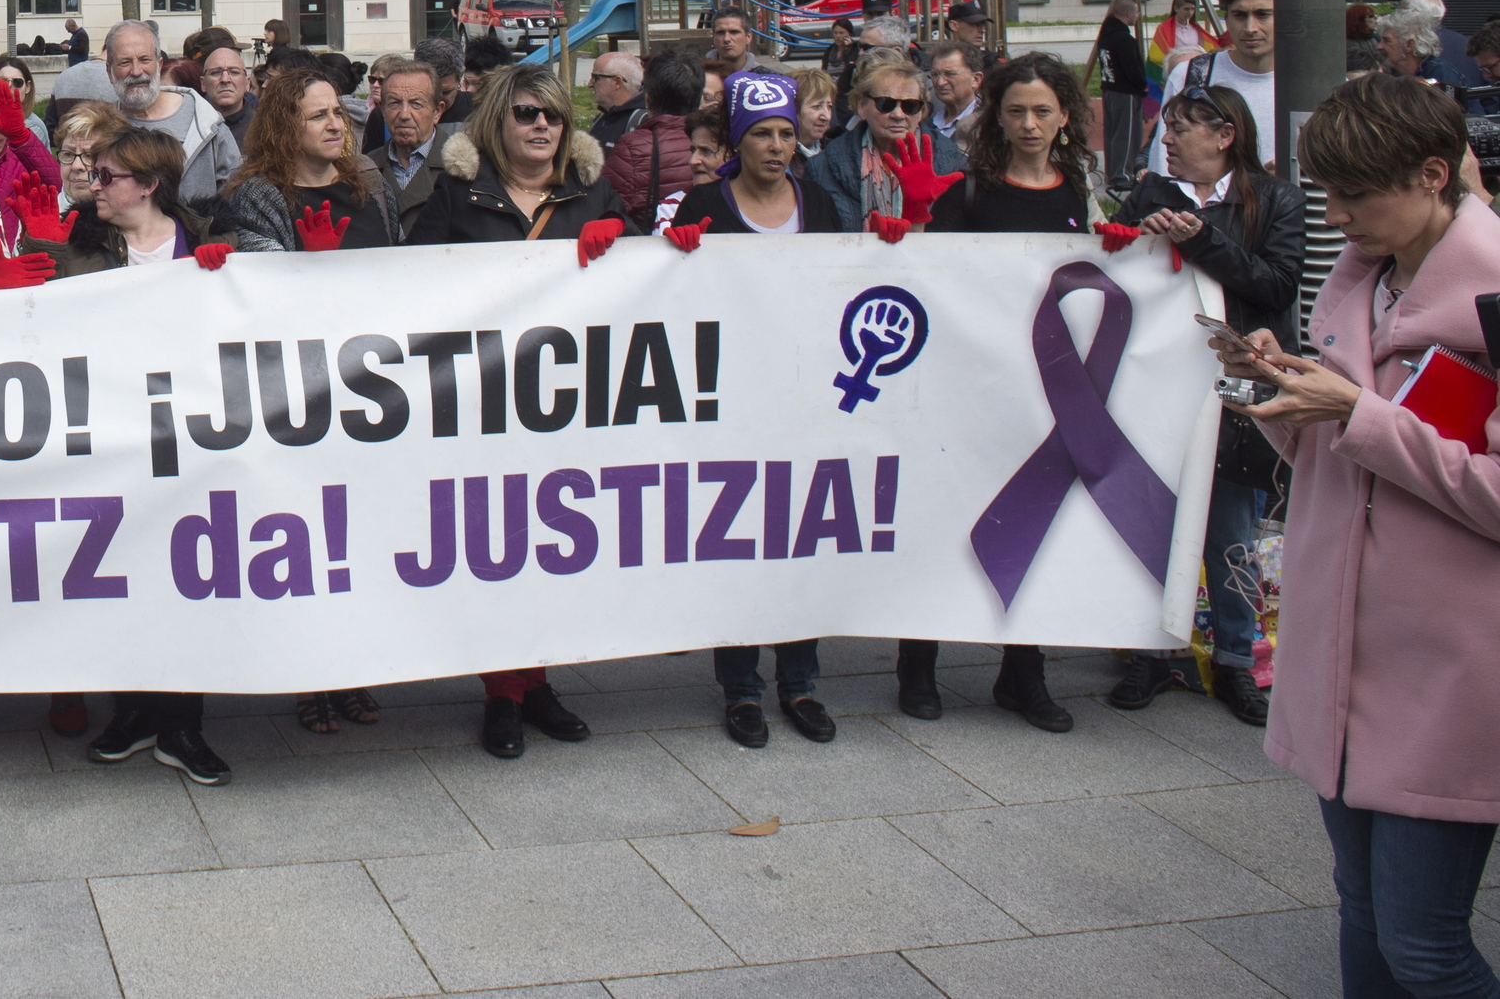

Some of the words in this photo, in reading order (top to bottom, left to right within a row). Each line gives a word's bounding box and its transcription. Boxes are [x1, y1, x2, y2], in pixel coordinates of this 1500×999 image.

[146, 321, 721, 478] ¡JUSTICIA!
[170, 484, 352, 600] da!
[394, 455, 900, 587] JUSTIZIA!
